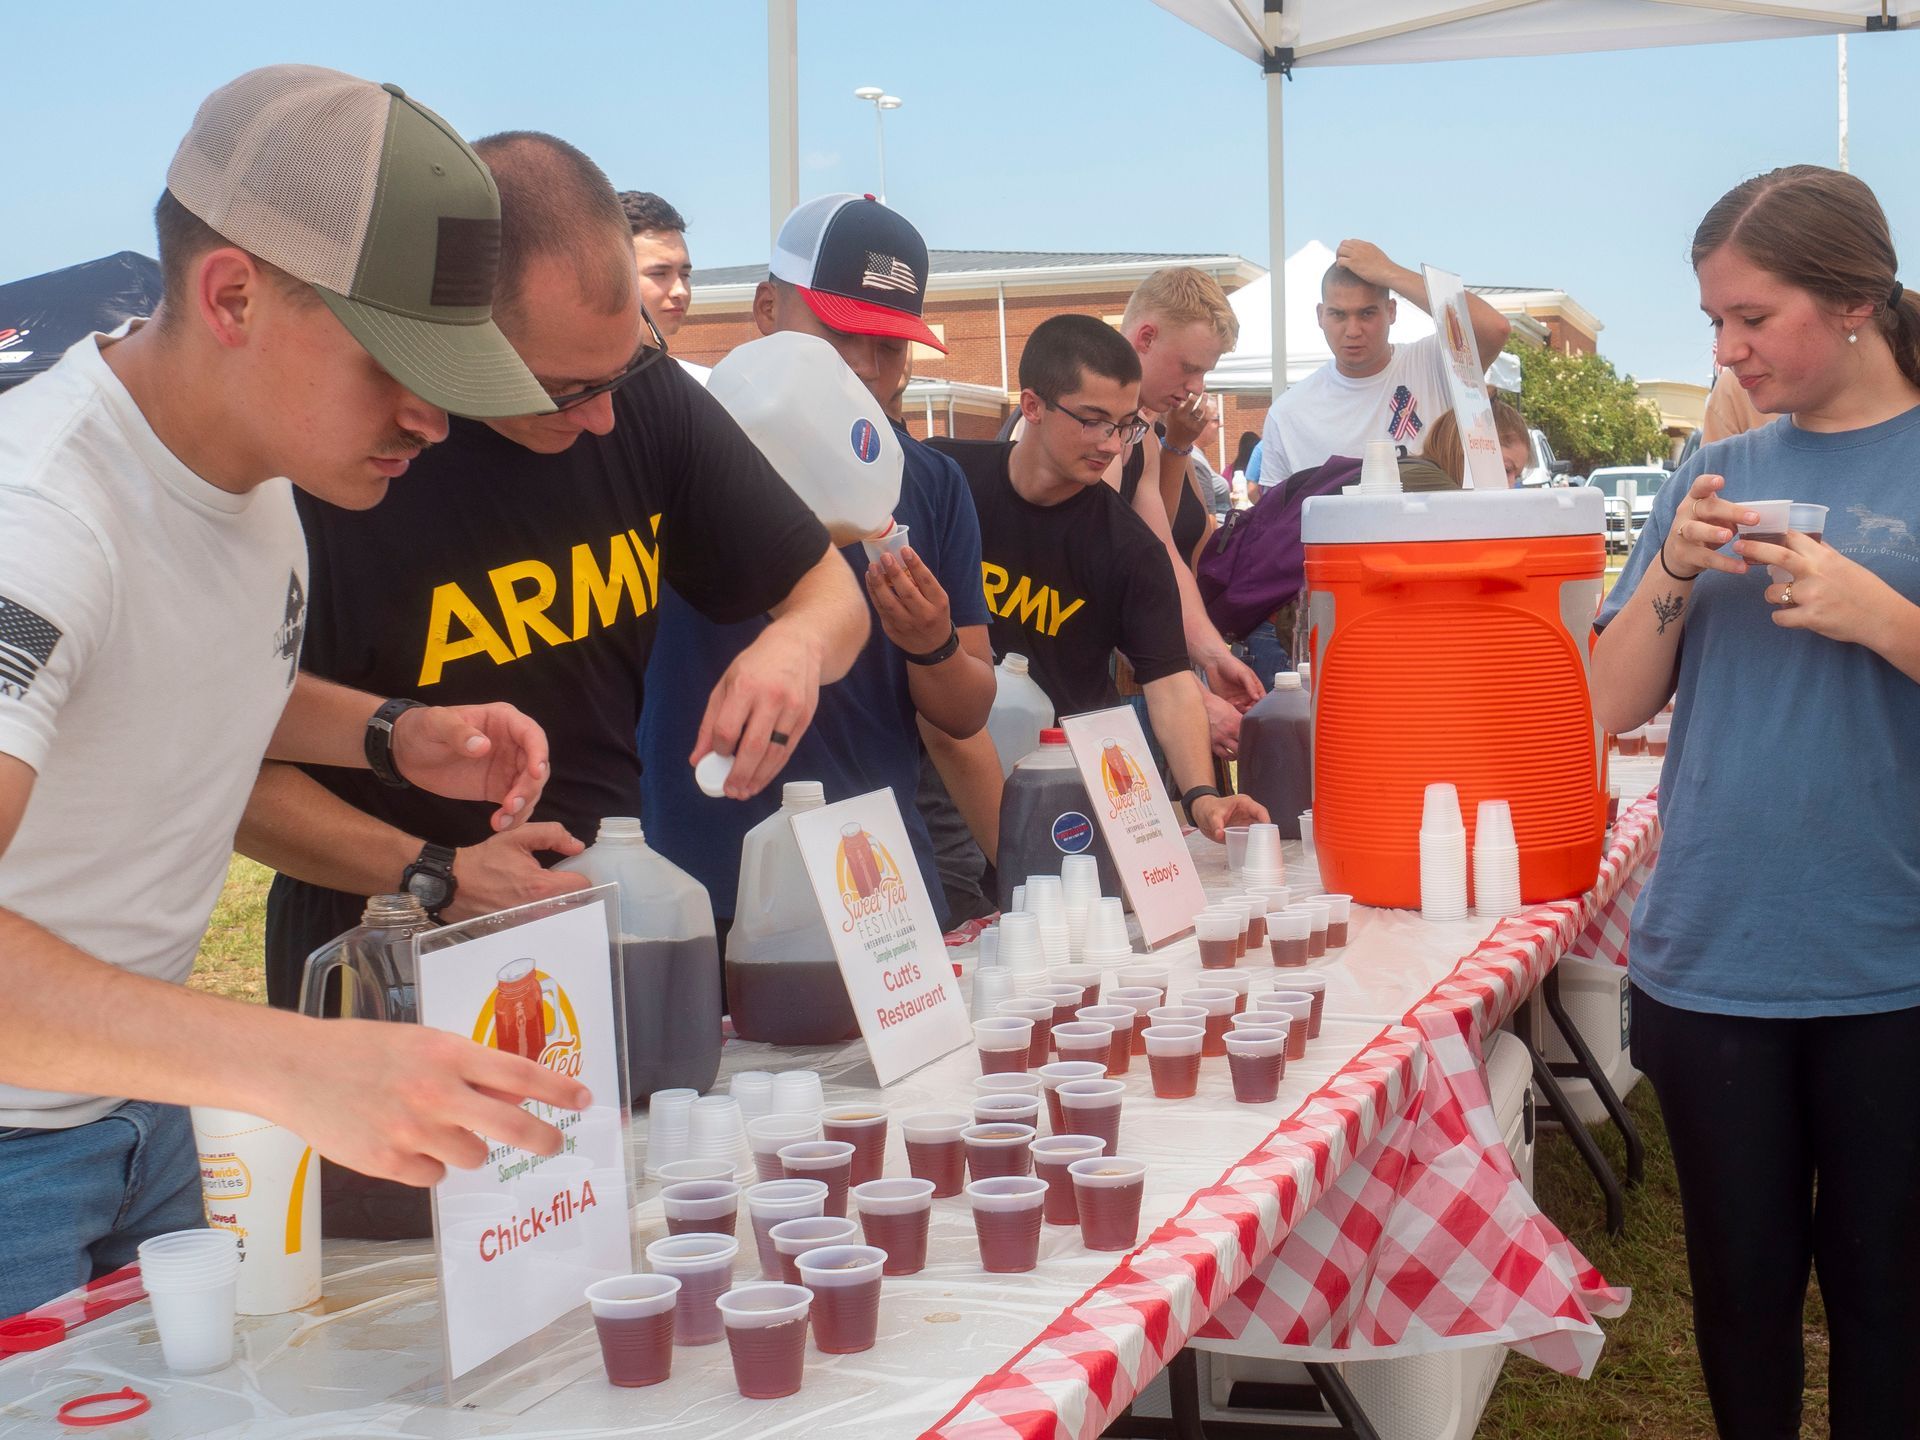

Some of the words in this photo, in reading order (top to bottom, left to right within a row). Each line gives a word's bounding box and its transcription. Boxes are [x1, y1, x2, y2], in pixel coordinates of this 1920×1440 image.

[417, 512, 662, 687] ARMY
[981, 561, 1086, 637] RMY
[1108, 788, 1135, 819] Sweet
[1132, 780, 1152, 809] Tea
[1143, 861, 1180, 887] Fatboy's
[842, 886, 883, 933] Sweet
[880, 876, 907, 913] Tea
[857, 905, 913, 940] FESTIVAL
[863, 932, 893, 951] ENTERPRISE
[883, 962, 921, 992] Cutt's
[876, 983, 947, 1031] Restaurant
[497, 1154, 530, 1183] Sample
[479, 1179, 597, 1263] Chick-fil-A
